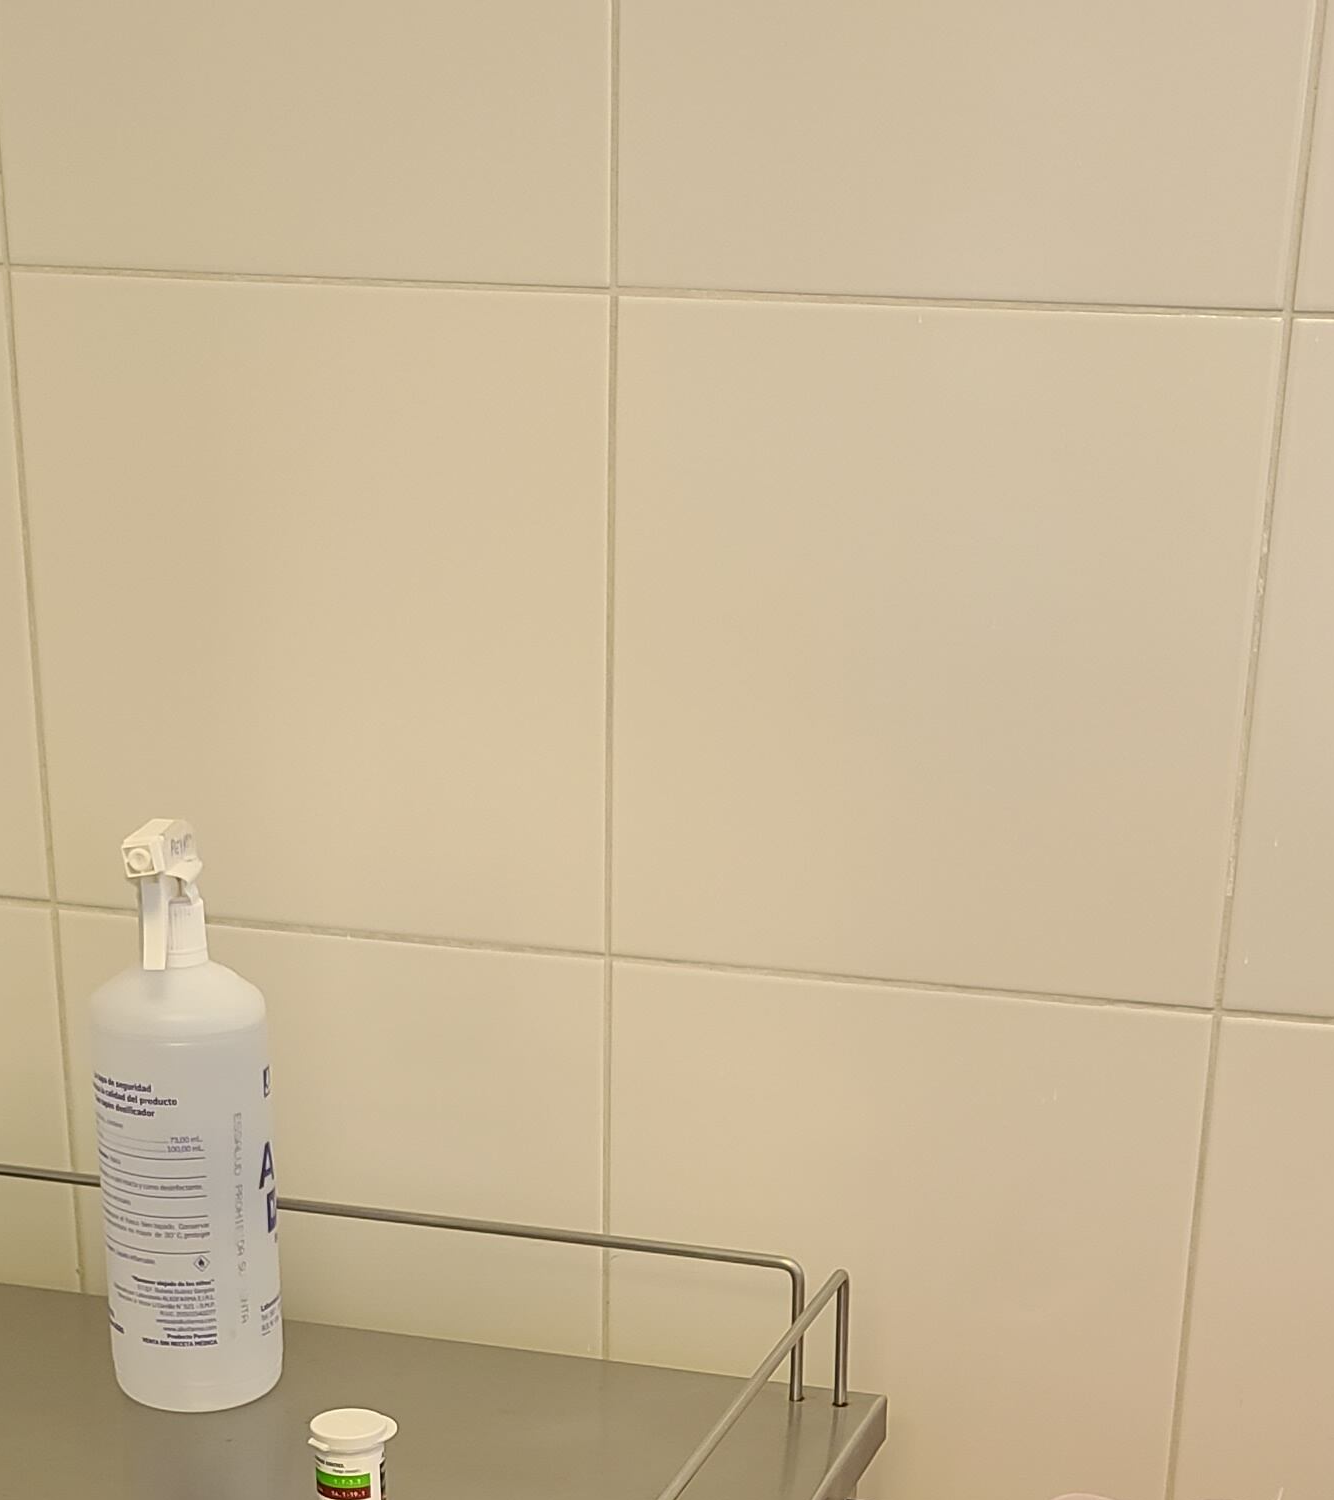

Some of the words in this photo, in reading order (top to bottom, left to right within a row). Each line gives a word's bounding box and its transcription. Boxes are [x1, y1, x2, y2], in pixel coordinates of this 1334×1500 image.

[116, 1081, 152, 1093] seguridad
[127, 1094, 138, 1104] del
[139, 1096, 178, 1106] producto
